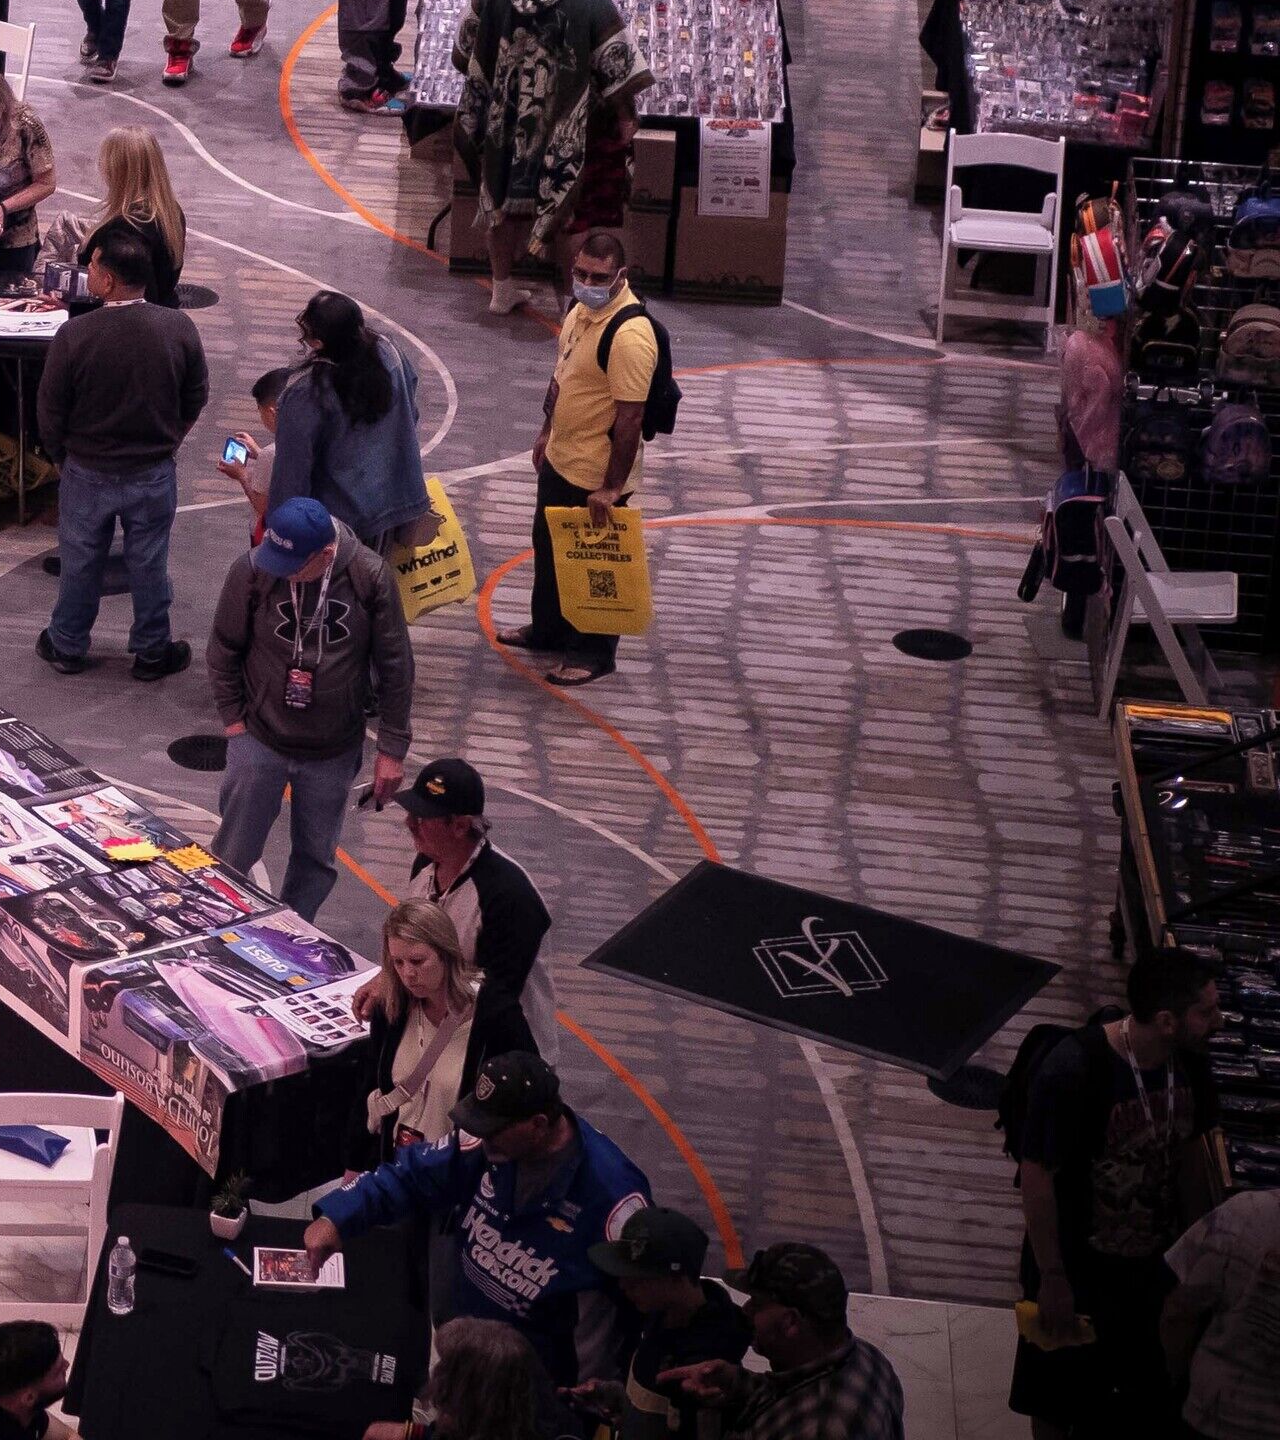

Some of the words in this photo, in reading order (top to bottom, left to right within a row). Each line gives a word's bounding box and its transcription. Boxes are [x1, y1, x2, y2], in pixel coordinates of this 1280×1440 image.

[397, 541, 459, 575] whatnot
[566, 551, 632, 562] COLLECTIBLES
[575, 541, 620, 551] FAVORITE
[241, 945, 289, 972] GUEST
[185, 1112, 218, 1157] John
[461, 1206, 559, 1287] Hendrick
[471, 1244, 541, 1301] cars.com
[254, 1330, 279, 1381] OUTLAW
